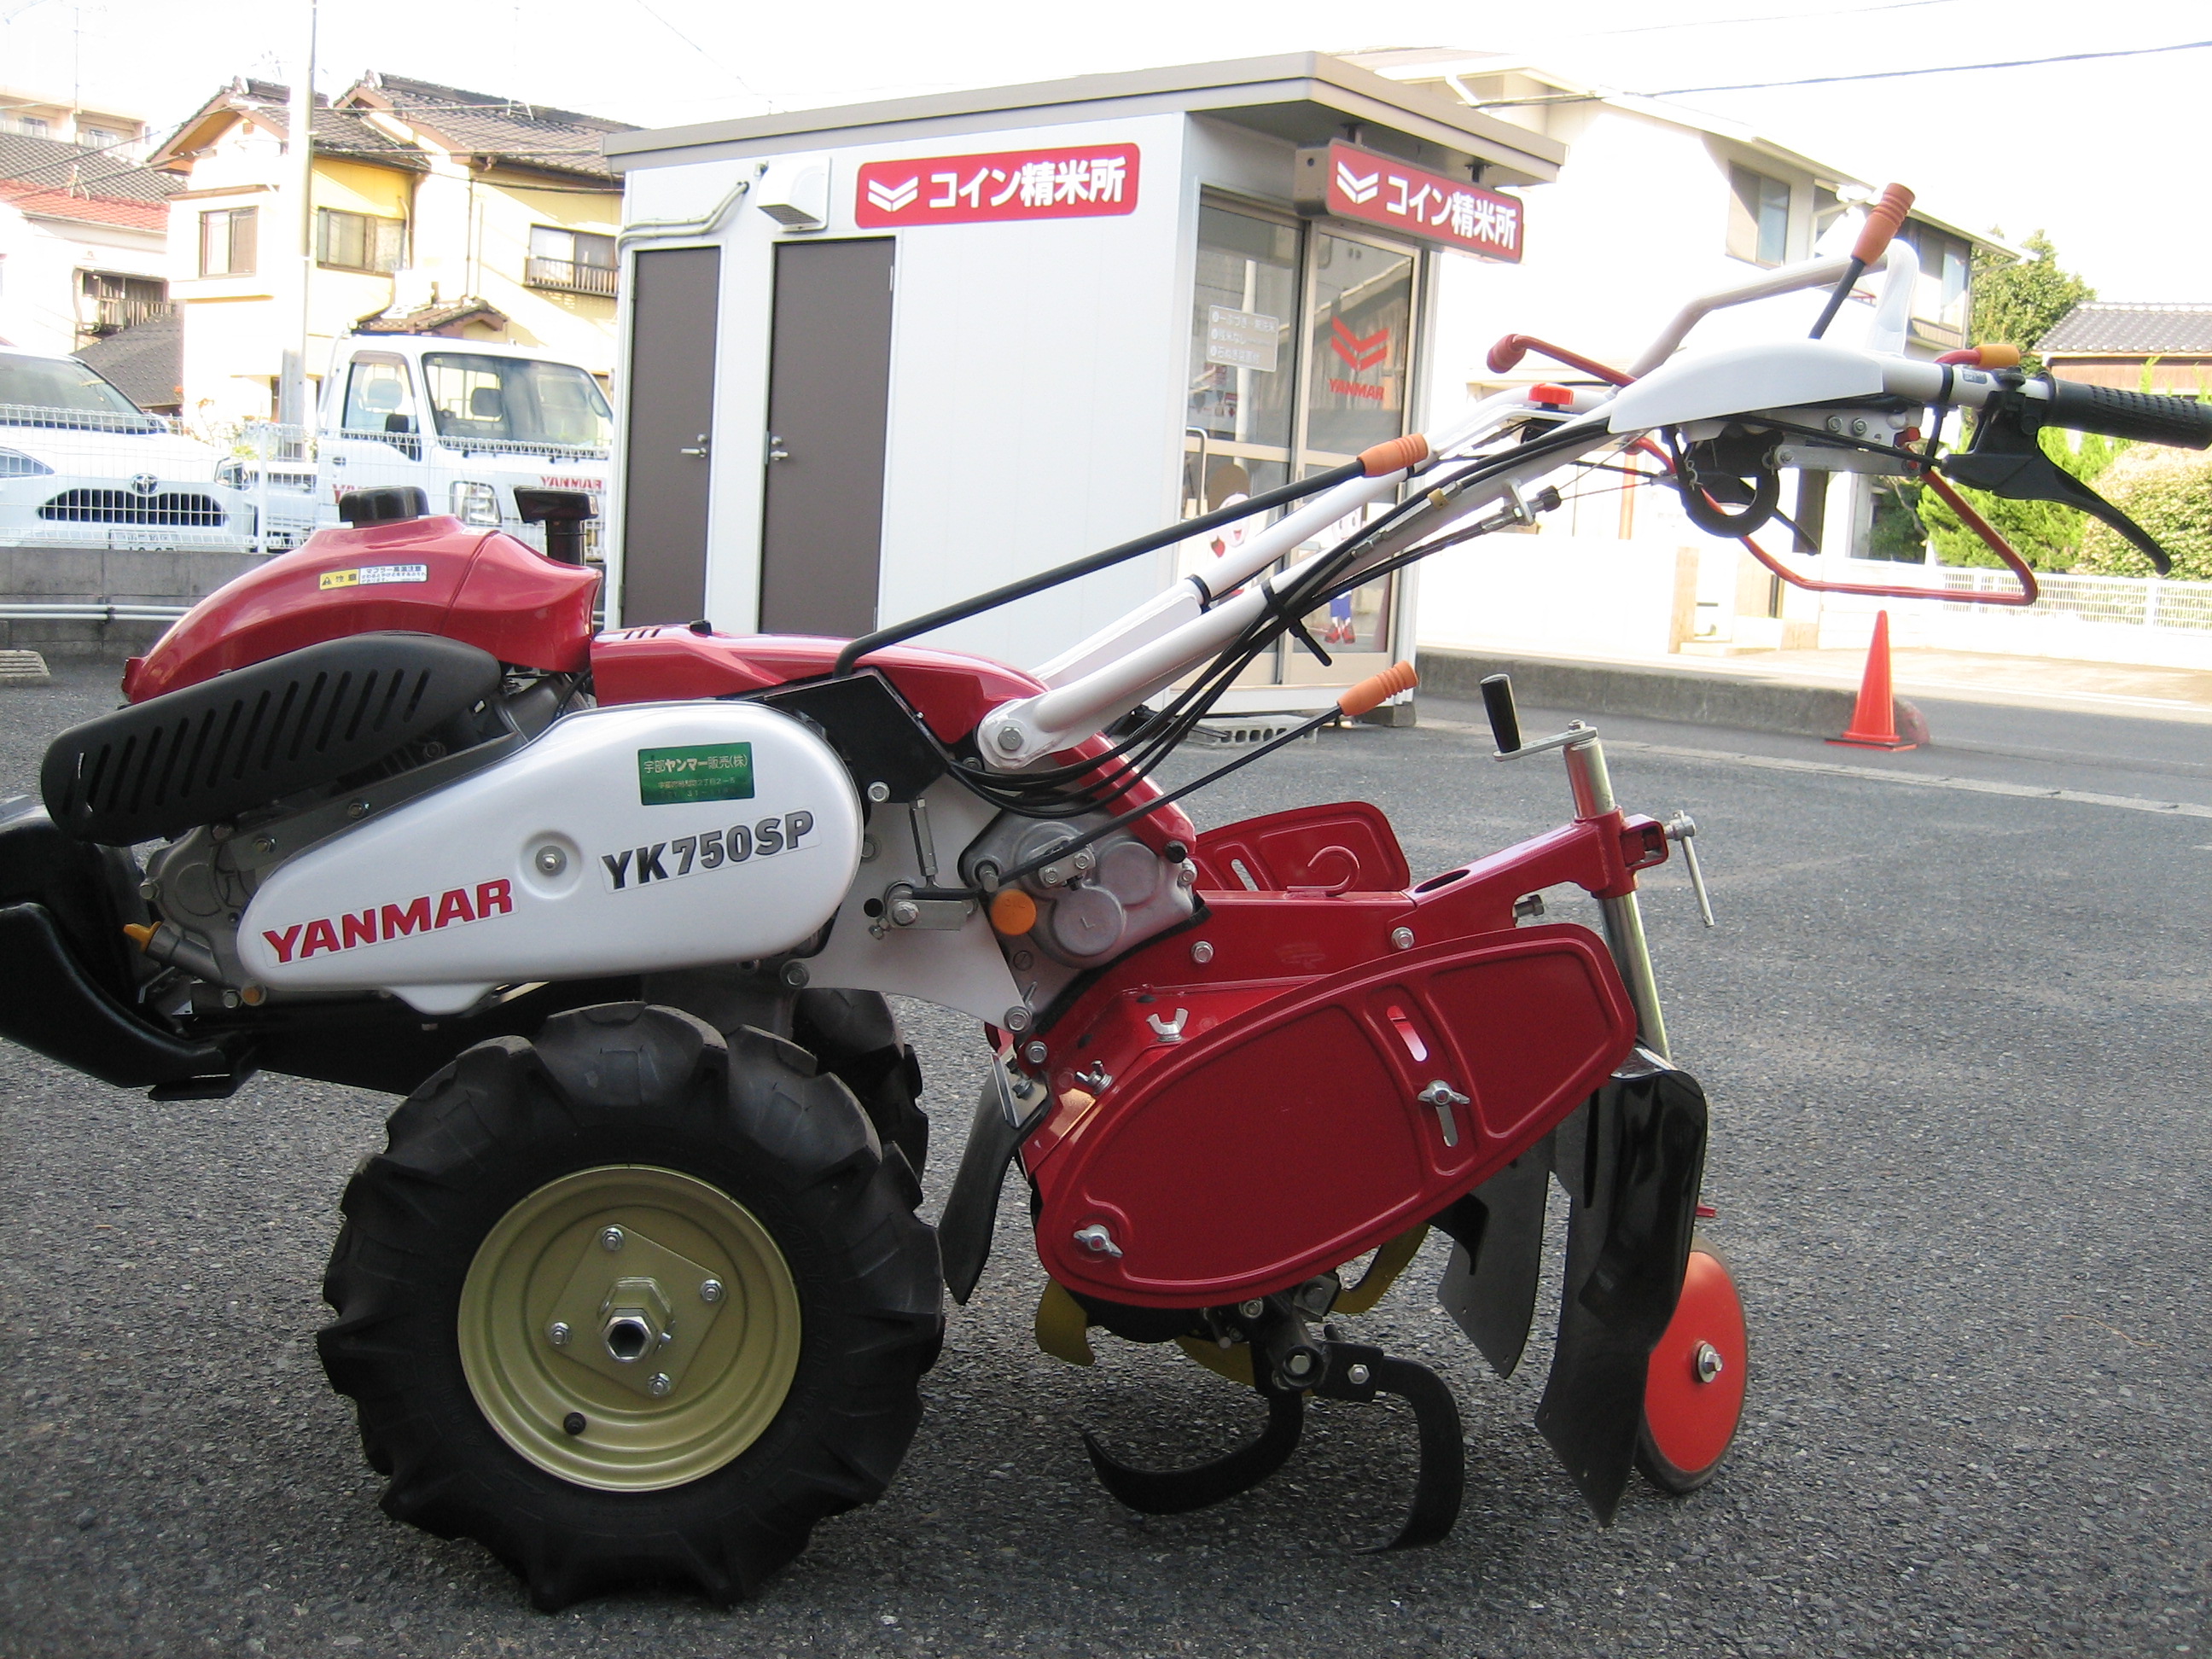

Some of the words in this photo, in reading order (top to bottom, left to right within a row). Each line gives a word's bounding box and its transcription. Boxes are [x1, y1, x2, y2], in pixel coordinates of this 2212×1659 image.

[928, 155, 1126, 208] コイン精米所
[1385, 175, 1517, 250] コイン精米所
[1329, 378, 1384, 401] YANMAR
[540, 476, 602, 489] YANMAR
[601, 809, 814, 890] YK750SP
[261, 877, 513, 963] YANMAR
